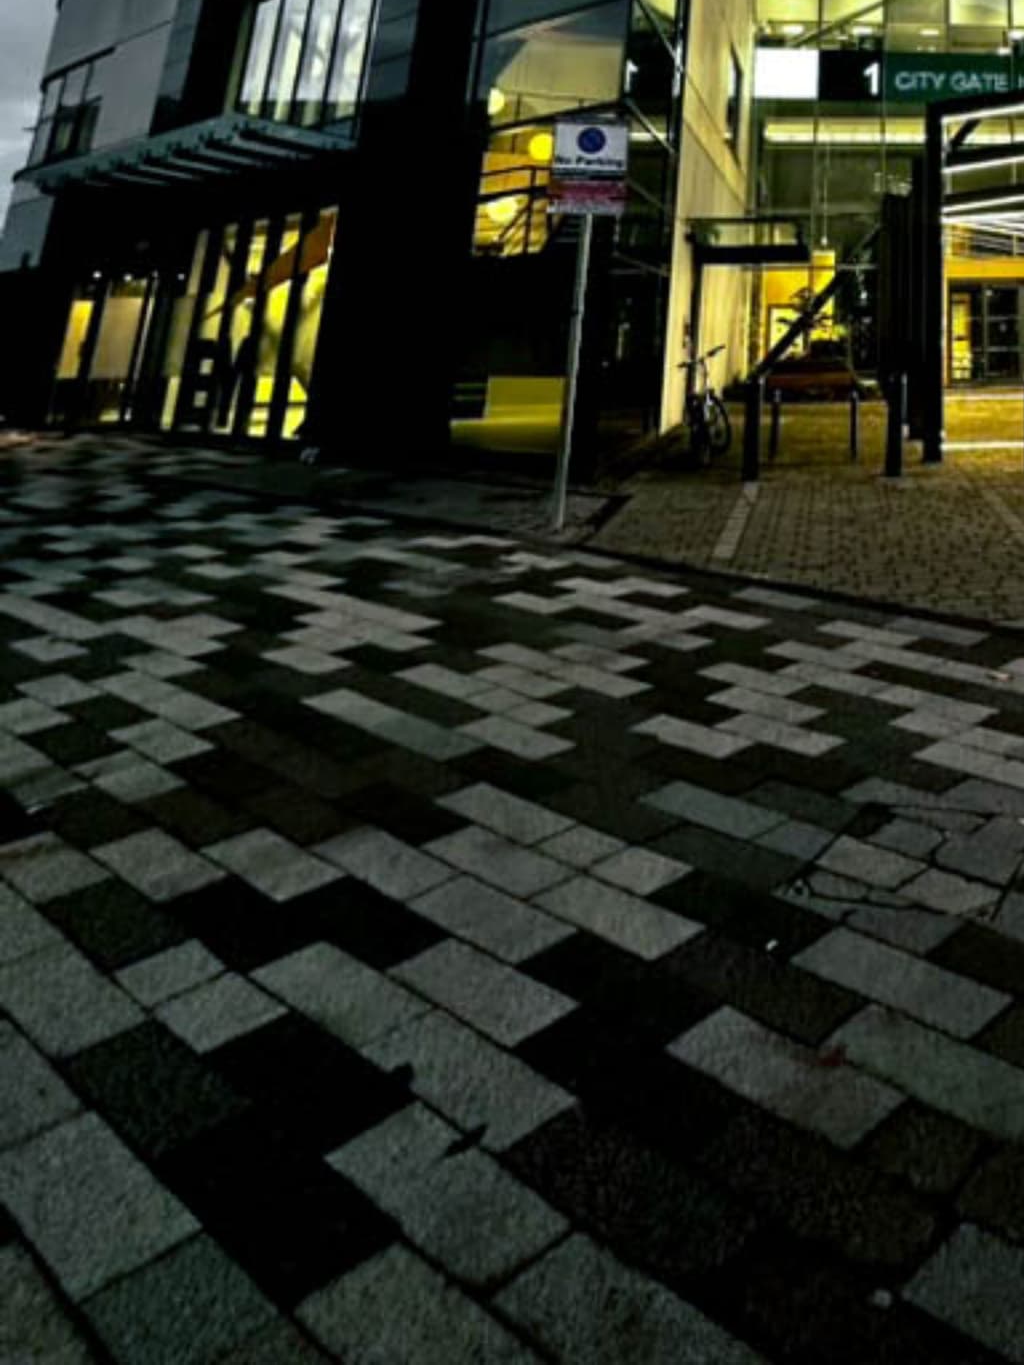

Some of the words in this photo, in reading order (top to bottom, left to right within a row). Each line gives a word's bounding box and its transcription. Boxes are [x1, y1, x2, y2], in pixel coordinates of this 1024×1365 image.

[863, 62, 881, 96] 1
[895, 71, 946, 92] CITY
[951, 70, 1011, 93] GATE
